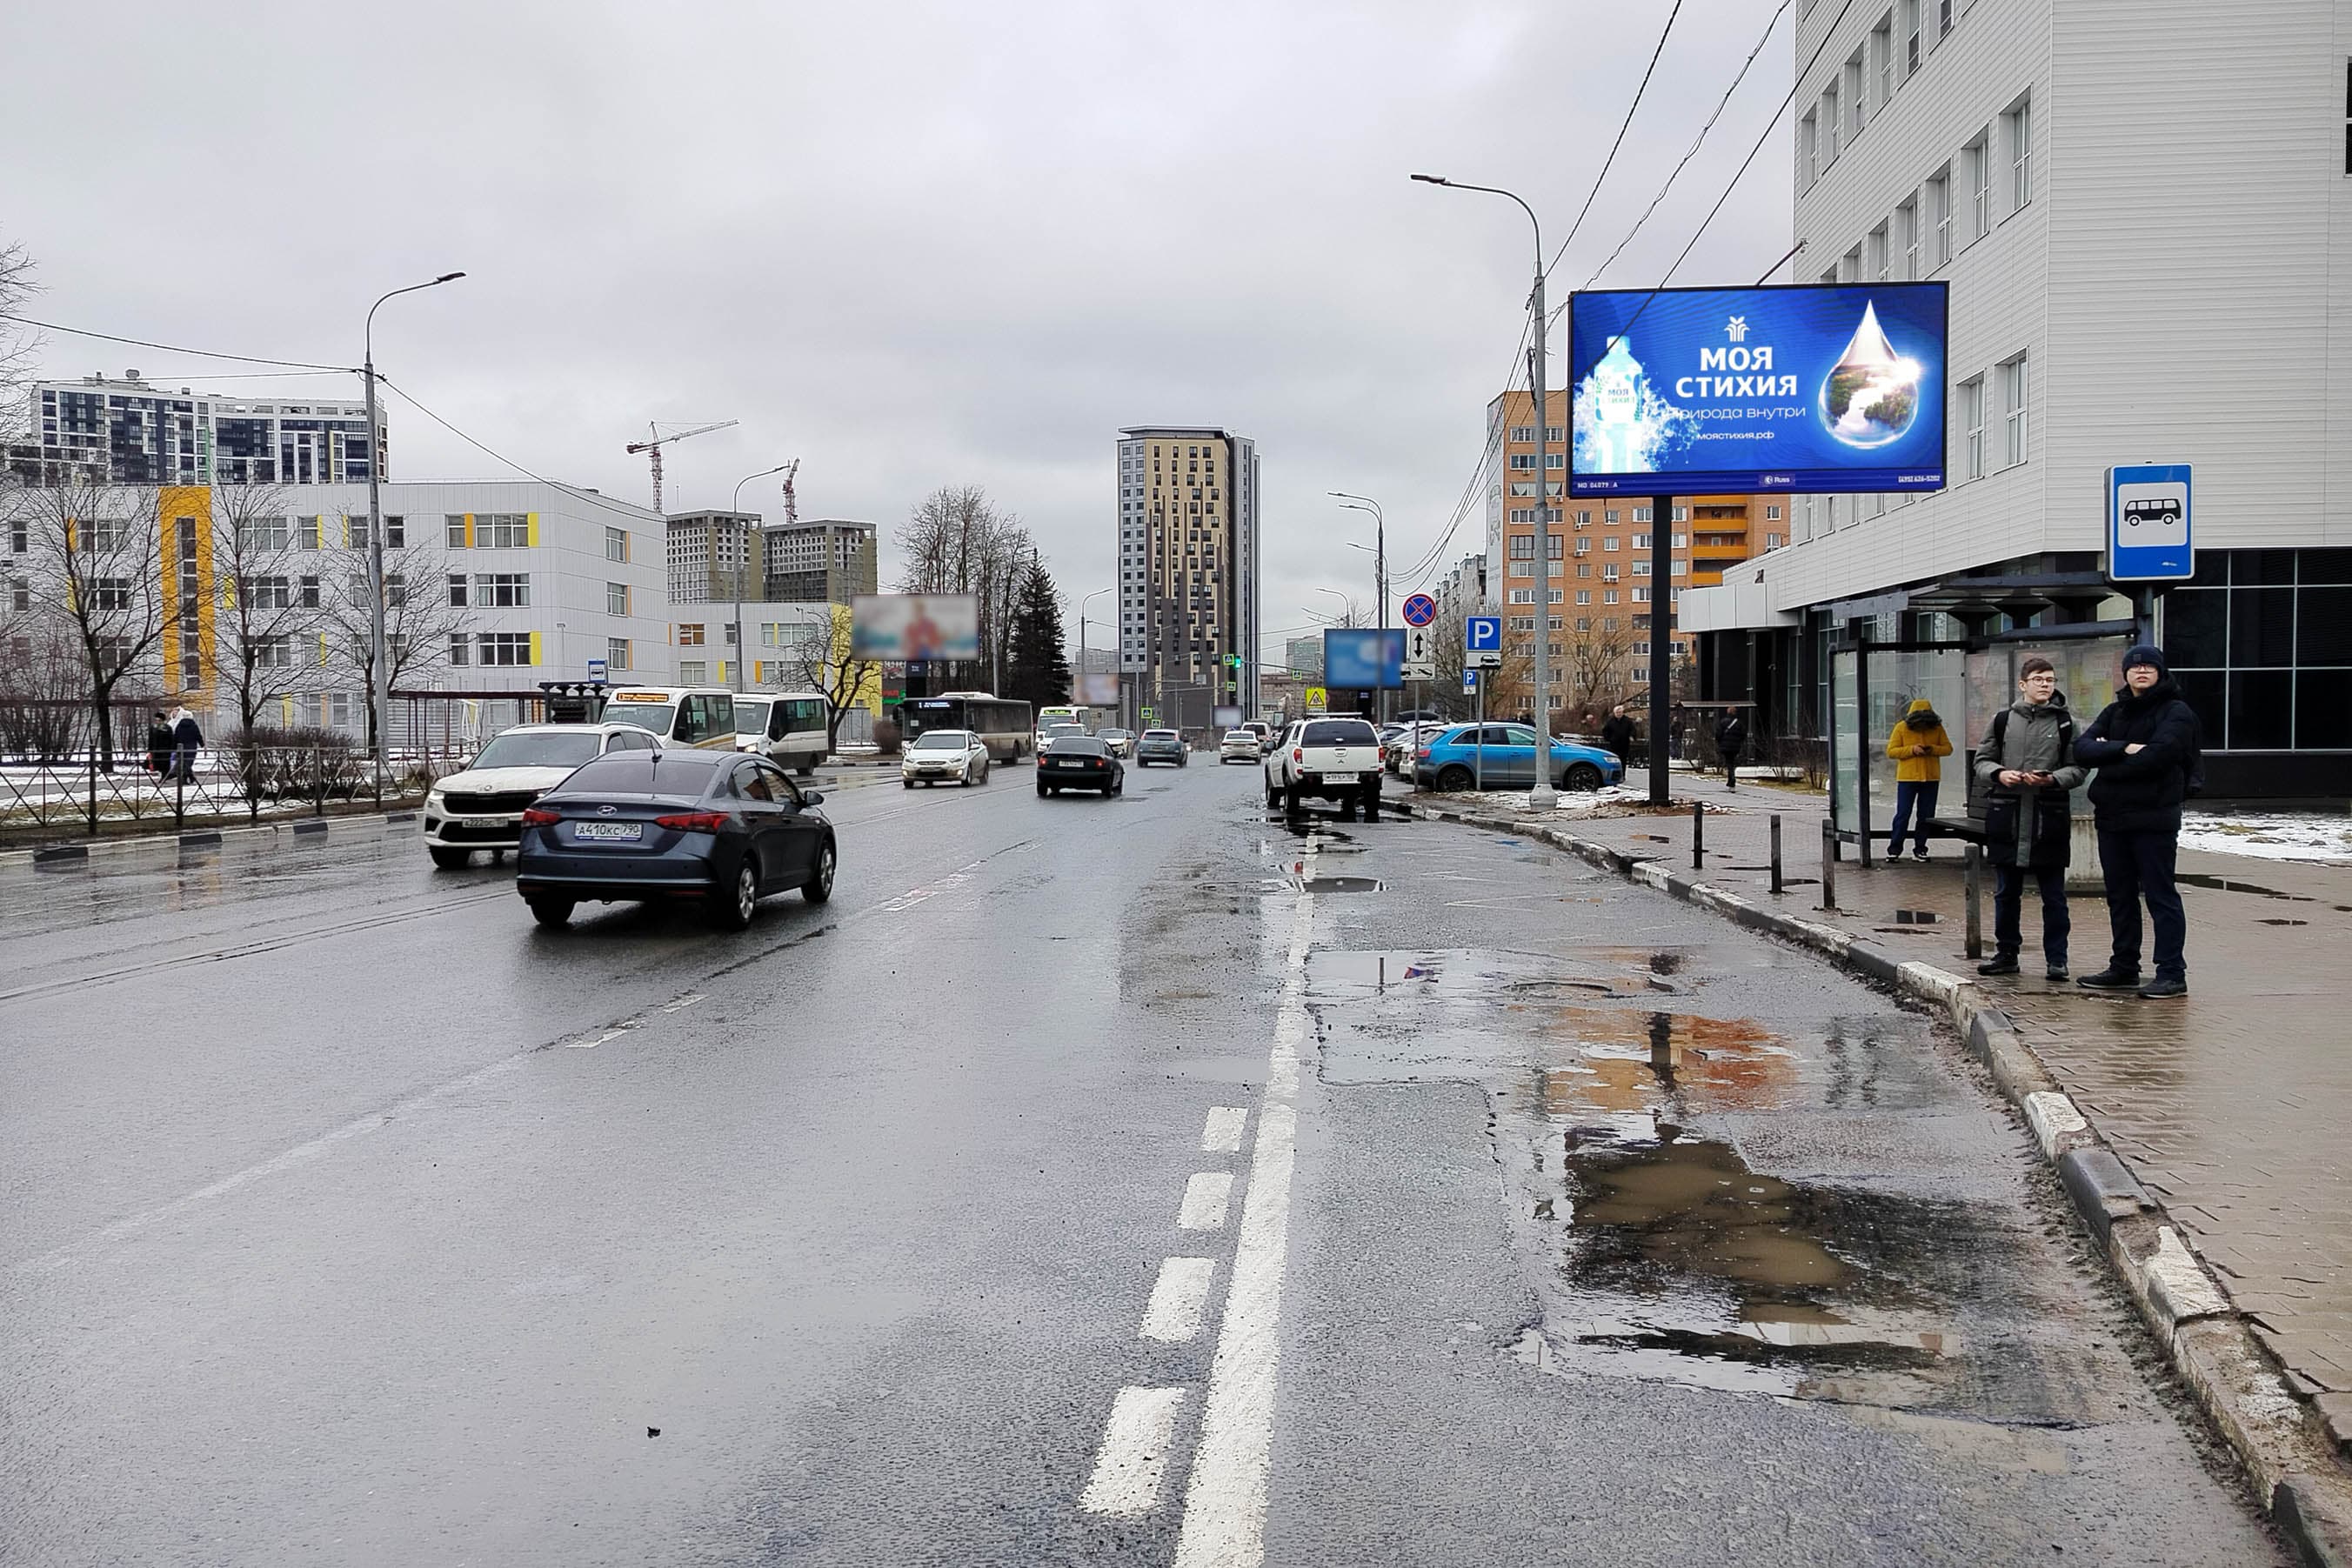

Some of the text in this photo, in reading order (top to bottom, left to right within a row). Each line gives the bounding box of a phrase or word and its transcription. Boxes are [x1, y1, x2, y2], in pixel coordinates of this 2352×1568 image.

[1700, 346, 1773, 371] МОЯ
[1675, 375, 1797, 398] СТИХИЯ
[1747, 406, 1806, 419] внутри
[1697, 431, 1774, 440] моястихия.рф
[1474, 620, 1494, 648] P
[1466, 672, 1473, 684] P
